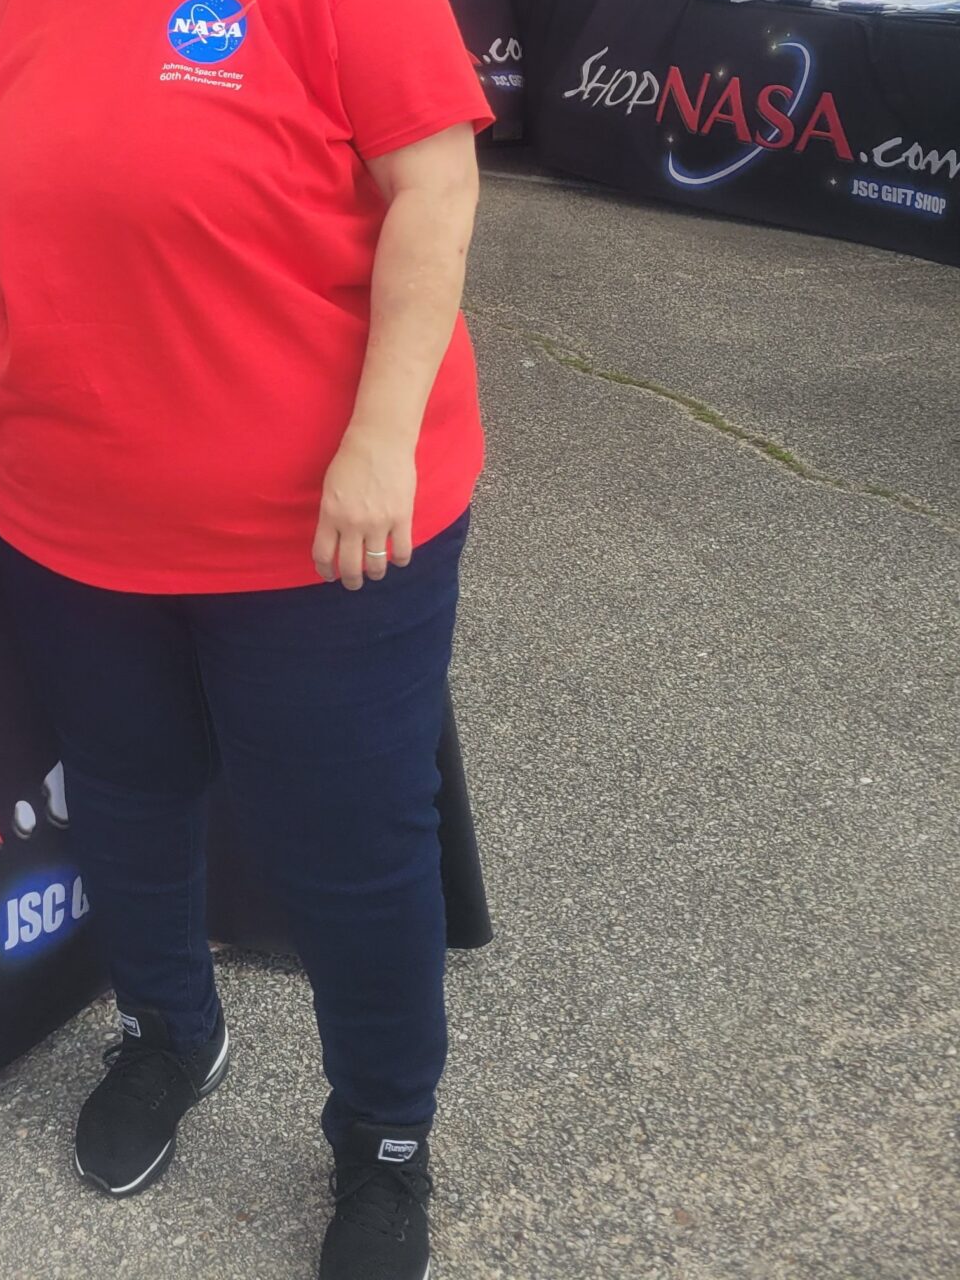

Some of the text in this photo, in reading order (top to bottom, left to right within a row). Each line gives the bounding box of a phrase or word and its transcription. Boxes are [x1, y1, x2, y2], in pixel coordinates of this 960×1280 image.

[172, 18, 243, 38] NASA
[162, 63, 244, 80] Johnson Space Center
[160, 72, 243, 91] 60th Anniversary
[851, 179, 947, 215] JSC GIFT SHOP
[4, 882, 66, 951] JSC
[384, 1141, 417, 1157] Running
